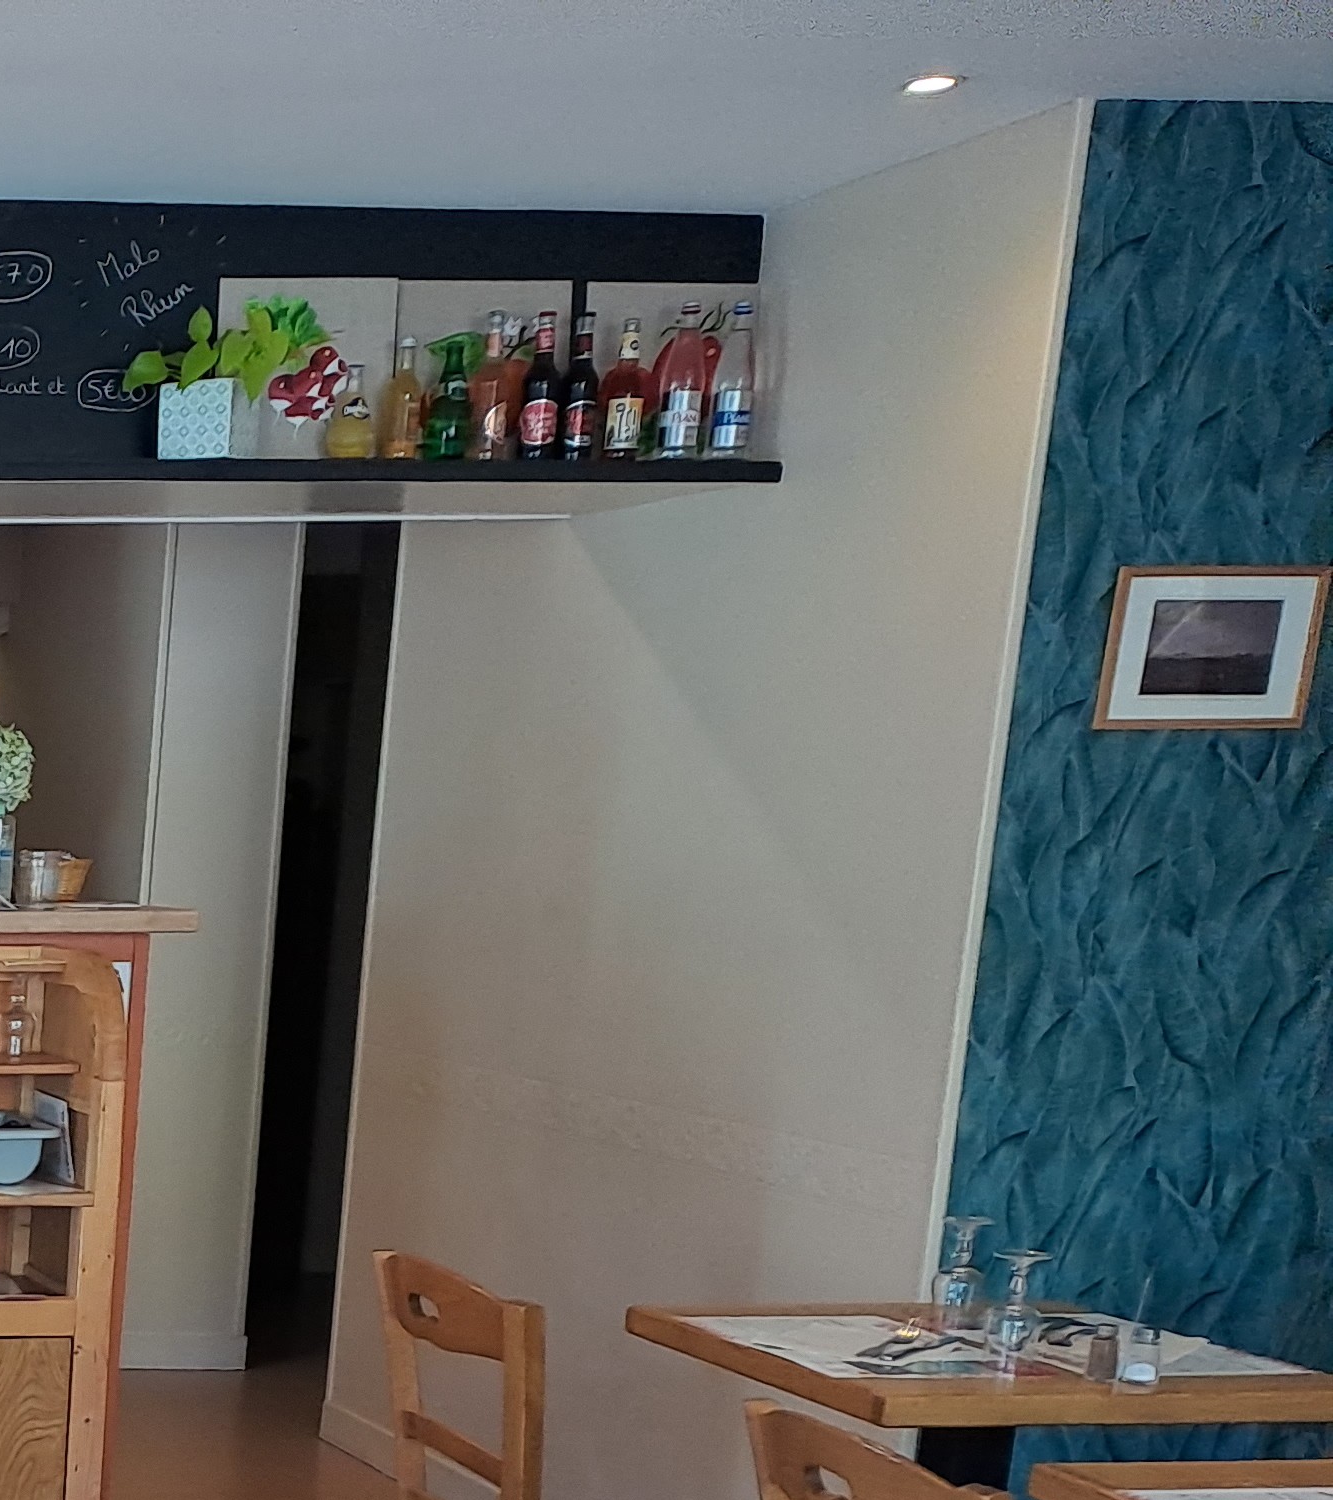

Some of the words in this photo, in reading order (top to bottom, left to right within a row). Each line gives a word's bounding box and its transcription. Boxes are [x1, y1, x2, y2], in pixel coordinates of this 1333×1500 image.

[97, 240, 160, 288] Malo
[120, 283, 195, 327] Rhum
[47, 373, 68, 395] et
